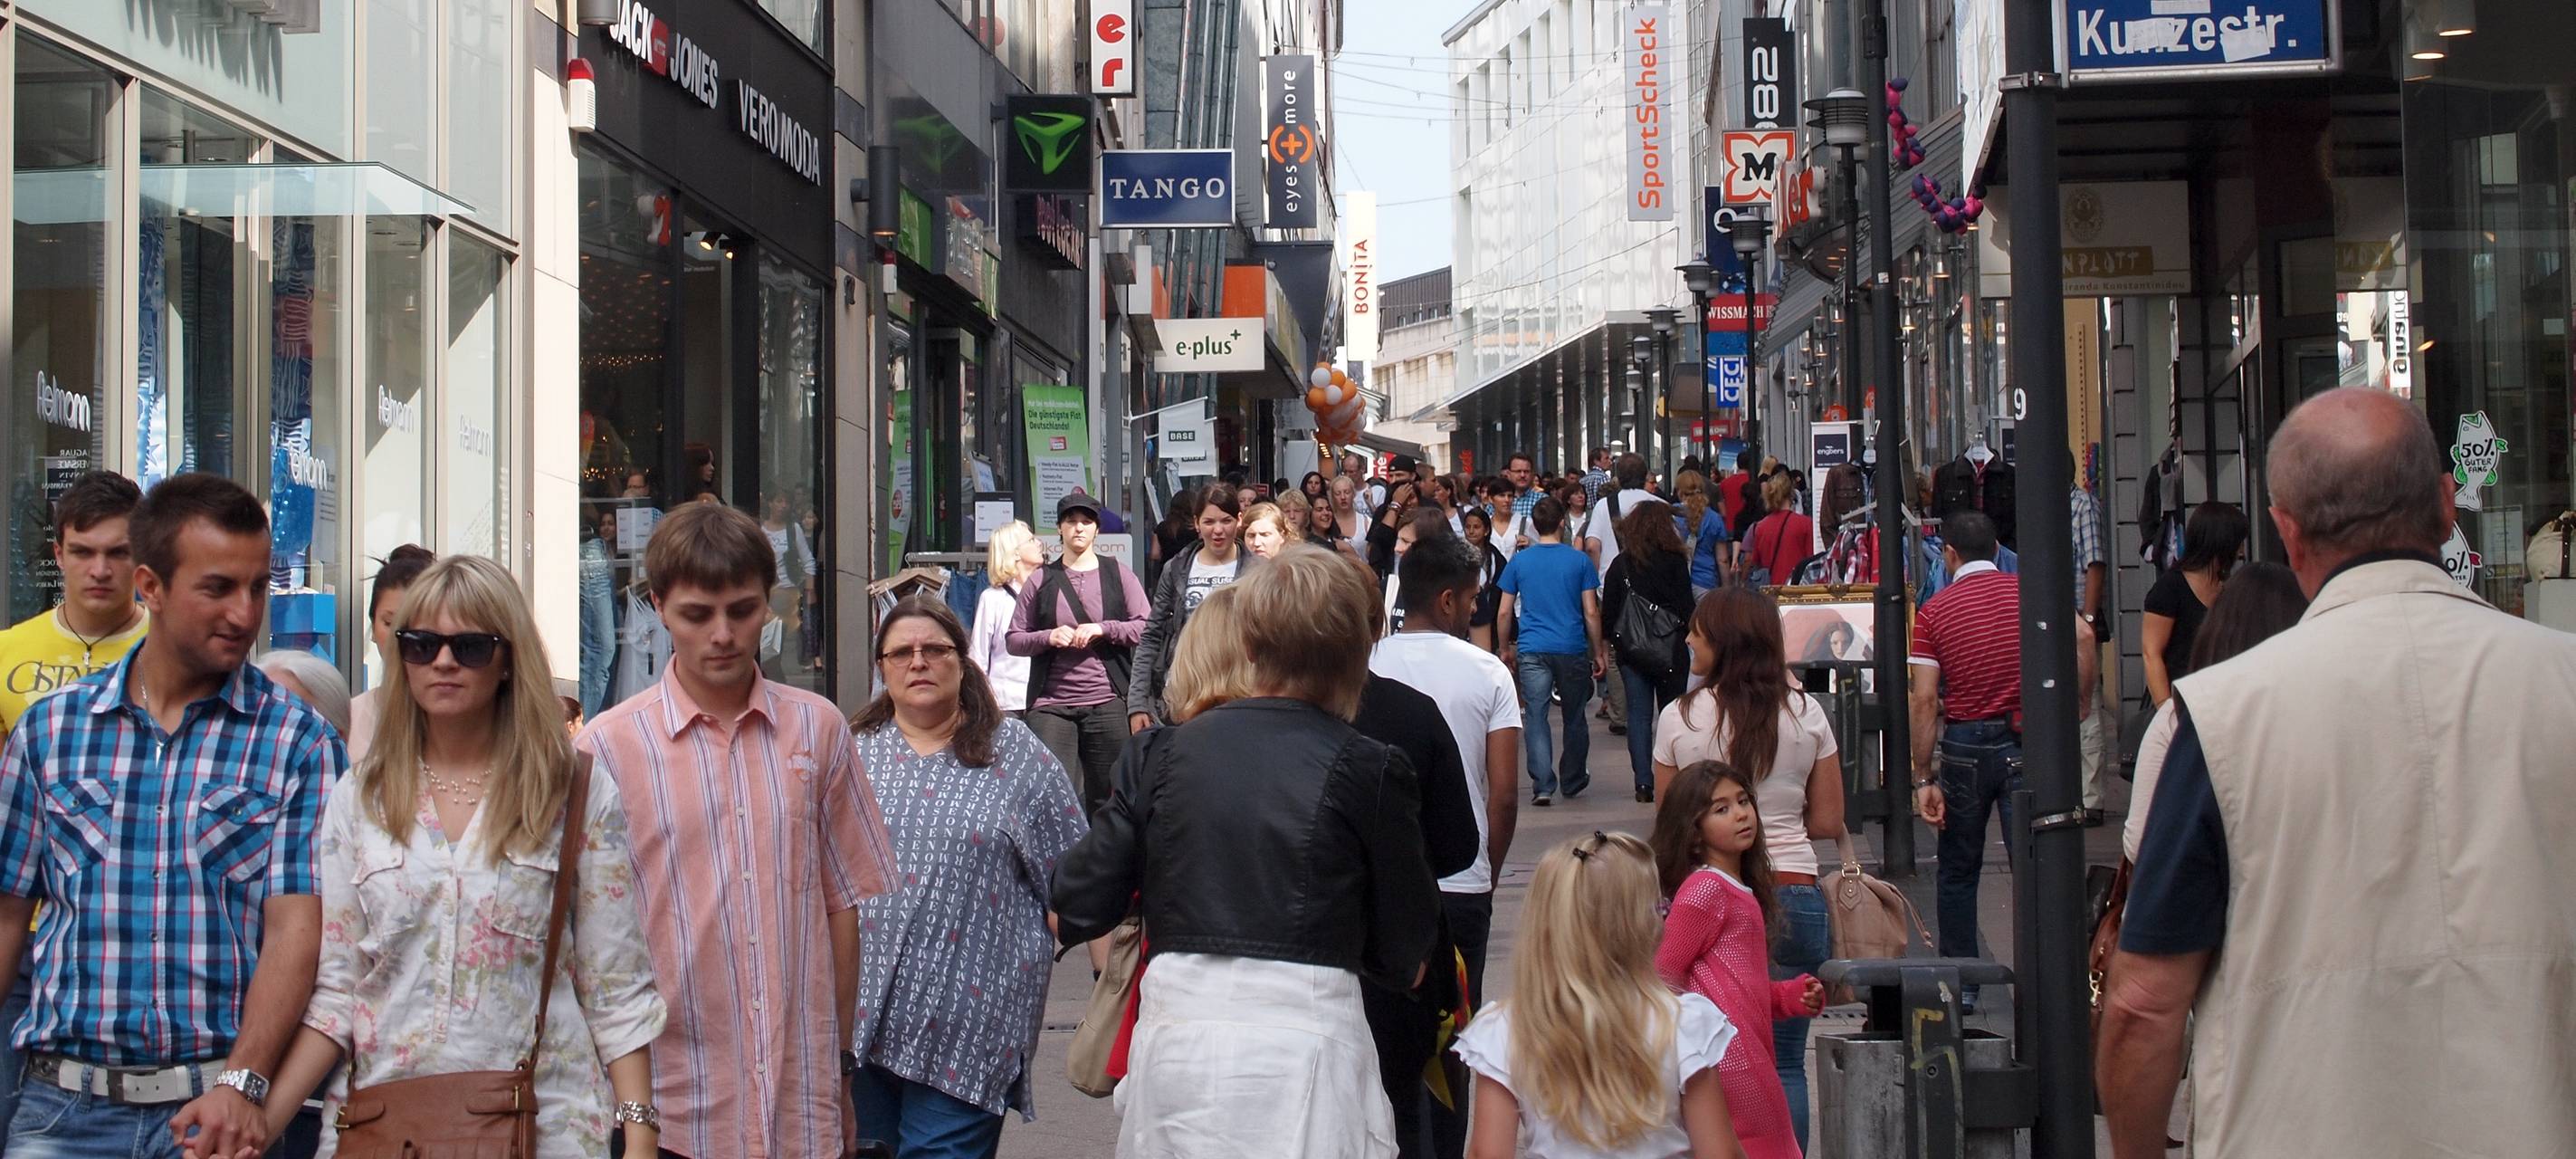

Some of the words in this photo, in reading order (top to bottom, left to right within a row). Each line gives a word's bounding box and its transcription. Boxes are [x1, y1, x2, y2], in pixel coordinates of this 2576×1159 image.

[609, 0, 655, 64] JACK
[670, 33, 718, 110] JONES
[2077, 5, 2296, 56] Kuzestr.
[1283, 70, 1296, 124] more
[1752, 46, 1779, 128] 82
[739, 79, 778, 155] VERO
[780, 112, 820, 187] MODA
[1635, 17, 1665, 209] SportScheck
[1109, 177, 1226, 200] TANGO
[1285, 164, 1302, 213] eyes
[1742, 152, 1777, 181] M
[2014, 389, 2027, 420] 9
[1169, 432, 1194, 441] BASE
[2461, 438, 2495, 458] 50%
[2465, 458, 2492, 466] GUTER
